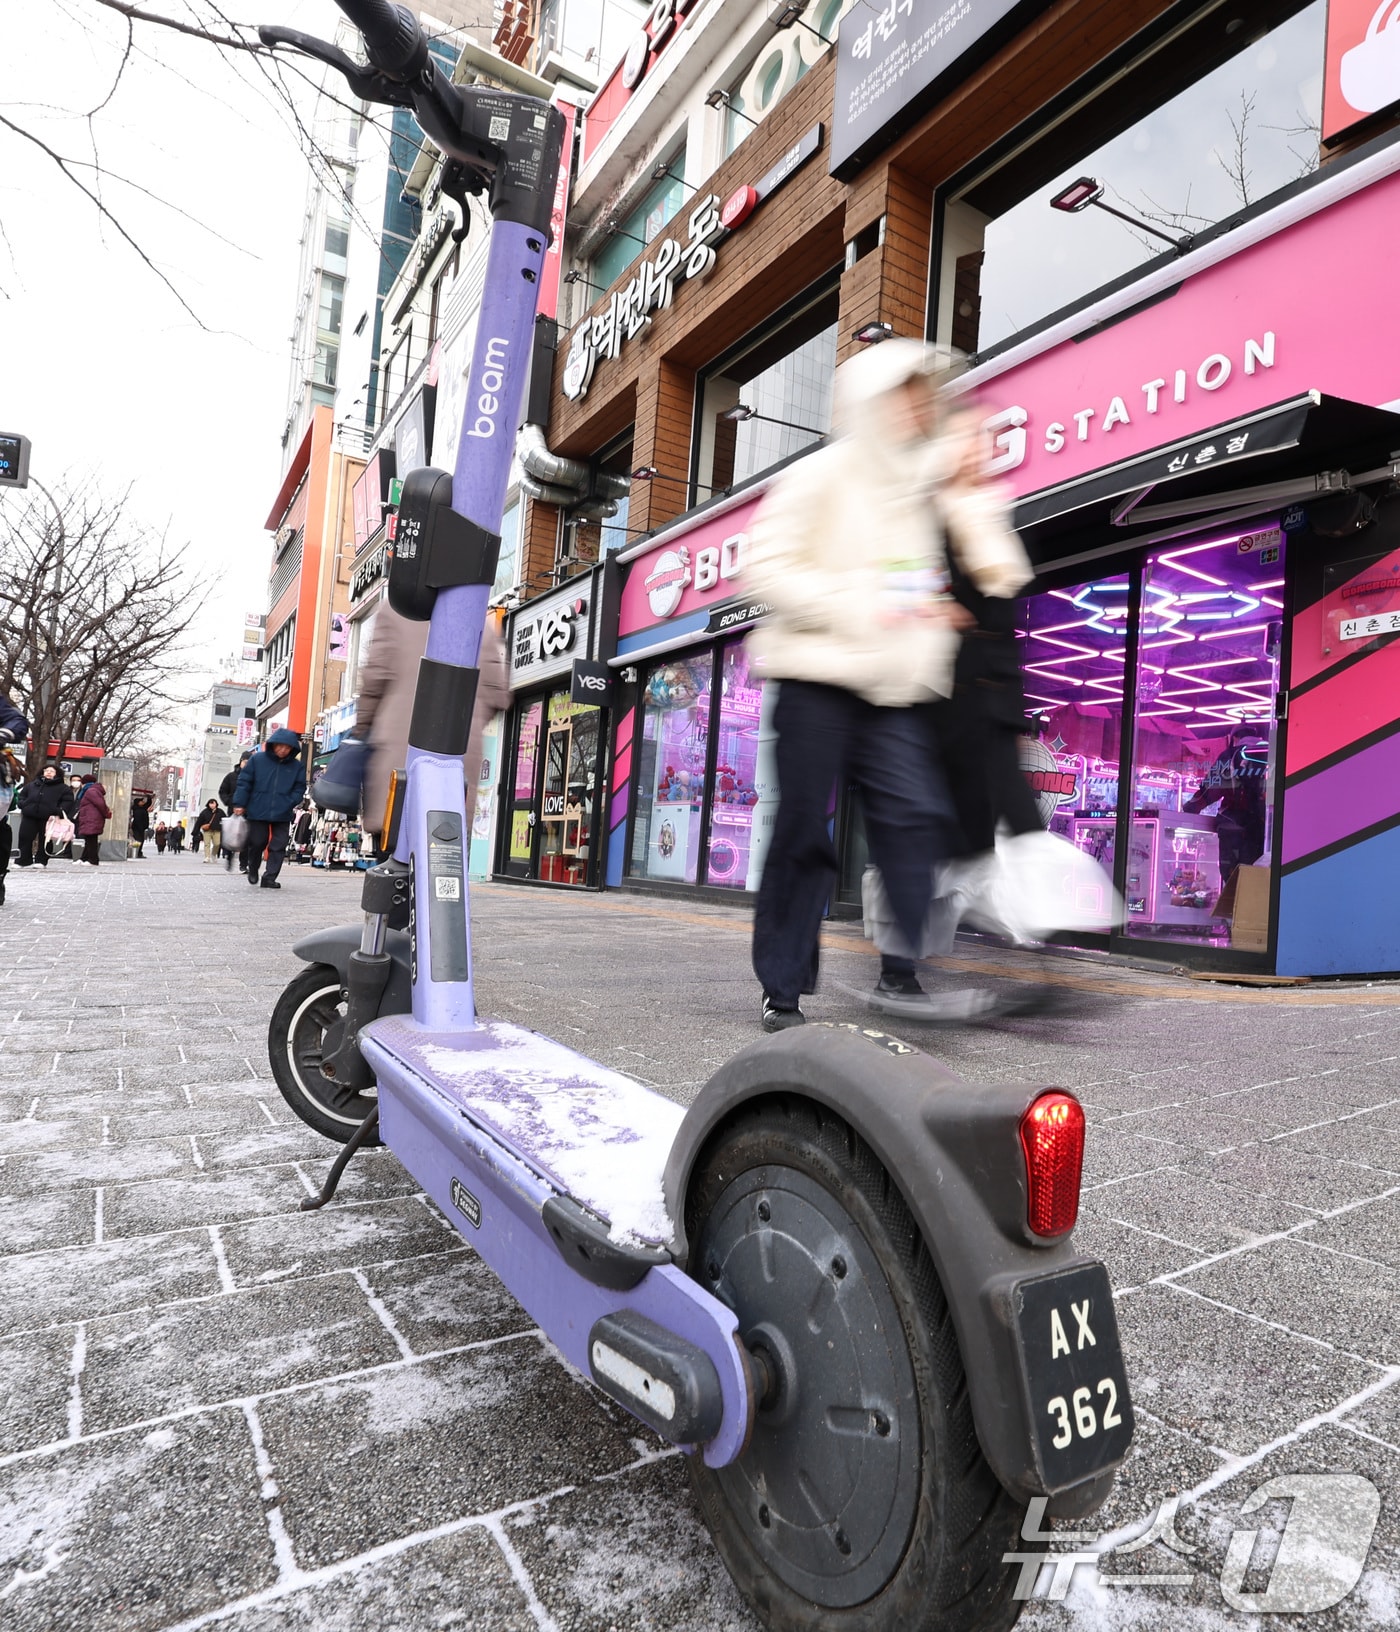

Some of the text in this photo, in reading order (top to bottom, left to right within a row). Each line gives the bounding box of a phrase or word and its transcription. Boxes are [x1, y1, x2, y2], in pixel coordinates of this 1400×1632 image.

[724, 190, 748, 220] 0410
[467, 337, 509, 438] beam
[1045, 331, 1276, 454] STATION
[1166, 432, 1249, 473] 신촌점
[1254, 529, 1280, 542] 금연구역
[720, 609, 748, 627] BONG
[516, 639, 531, 654] YOUR
[544, 795, 564, 813] LOVE
[1050, 1299, 1097, 1359] AX
[1047, 1378, 1122, 1450] 362
